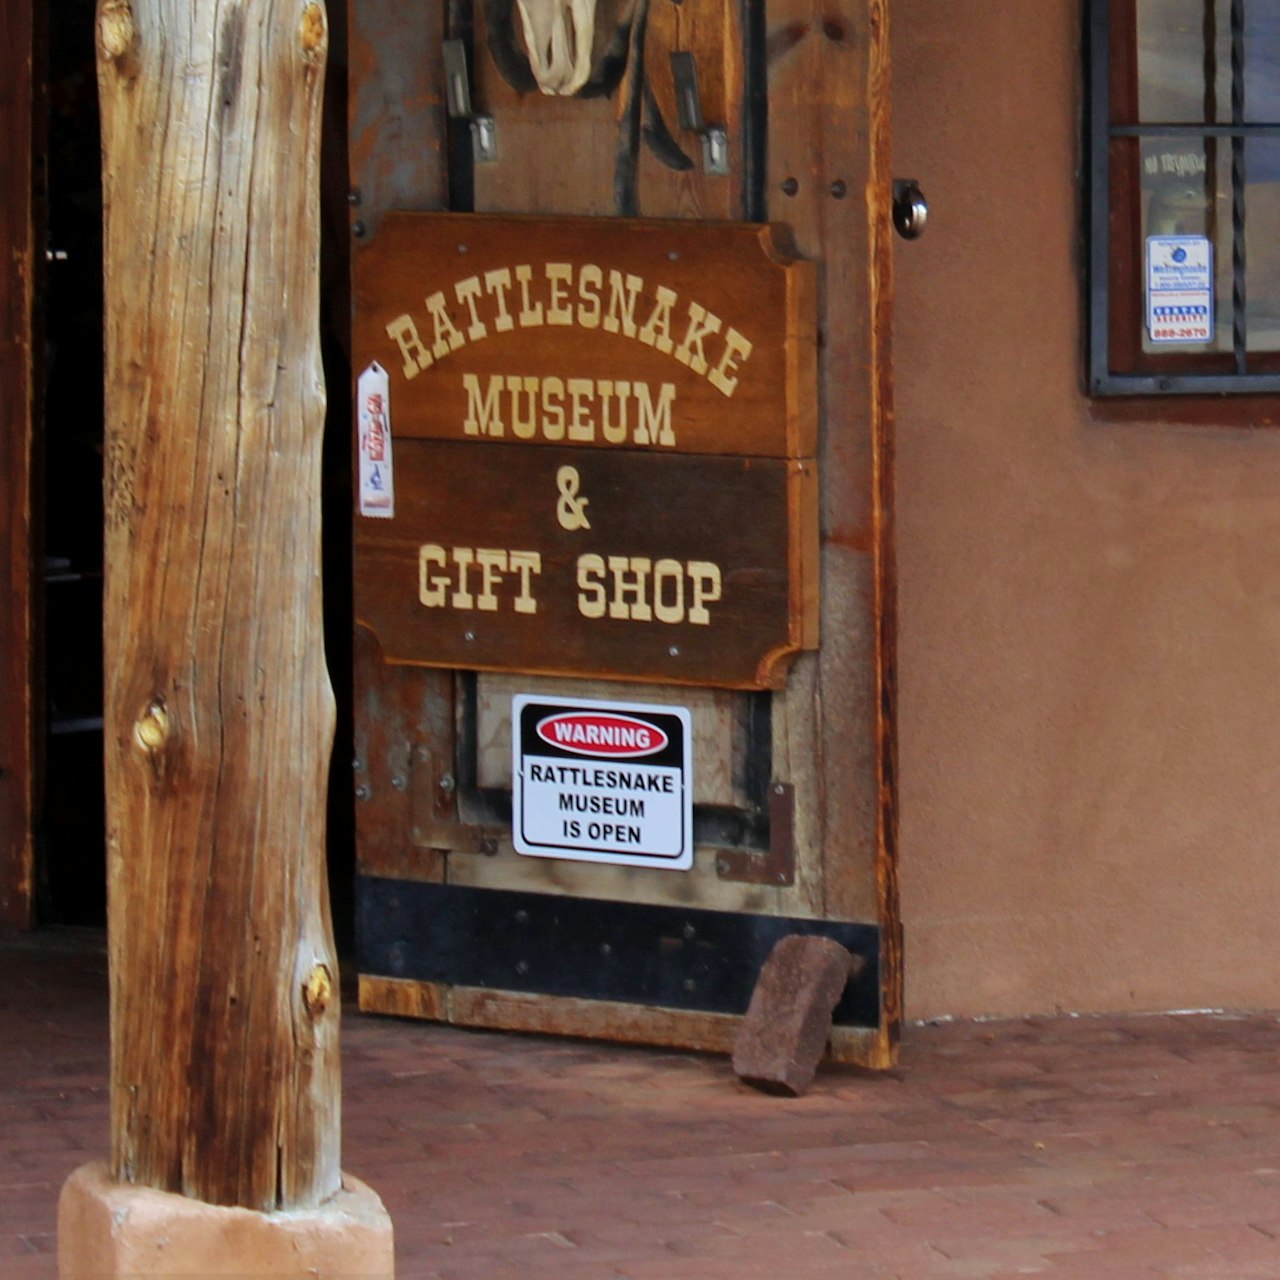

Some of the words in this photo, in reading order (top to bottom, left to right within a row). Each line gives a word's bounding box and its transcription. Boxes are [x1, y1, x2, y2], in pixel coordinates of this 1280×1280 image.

[385, 262, 753, 398] RATTLESNAKE
[463, 373, 676, 447] MUSEUM
[556, 465, 591, 531] &
[419, 544, 542, 614] GIFT
[576, 553, 722, 625] SHOP
[554, 721, 651, 750] WARNING
[530, 764, 674, 794] RATTLESNAKE
[559, 792, 645, 818] MUSEUM
[563, 819, 581, 839] IS
[588, 823, 642, 845] OPEN
